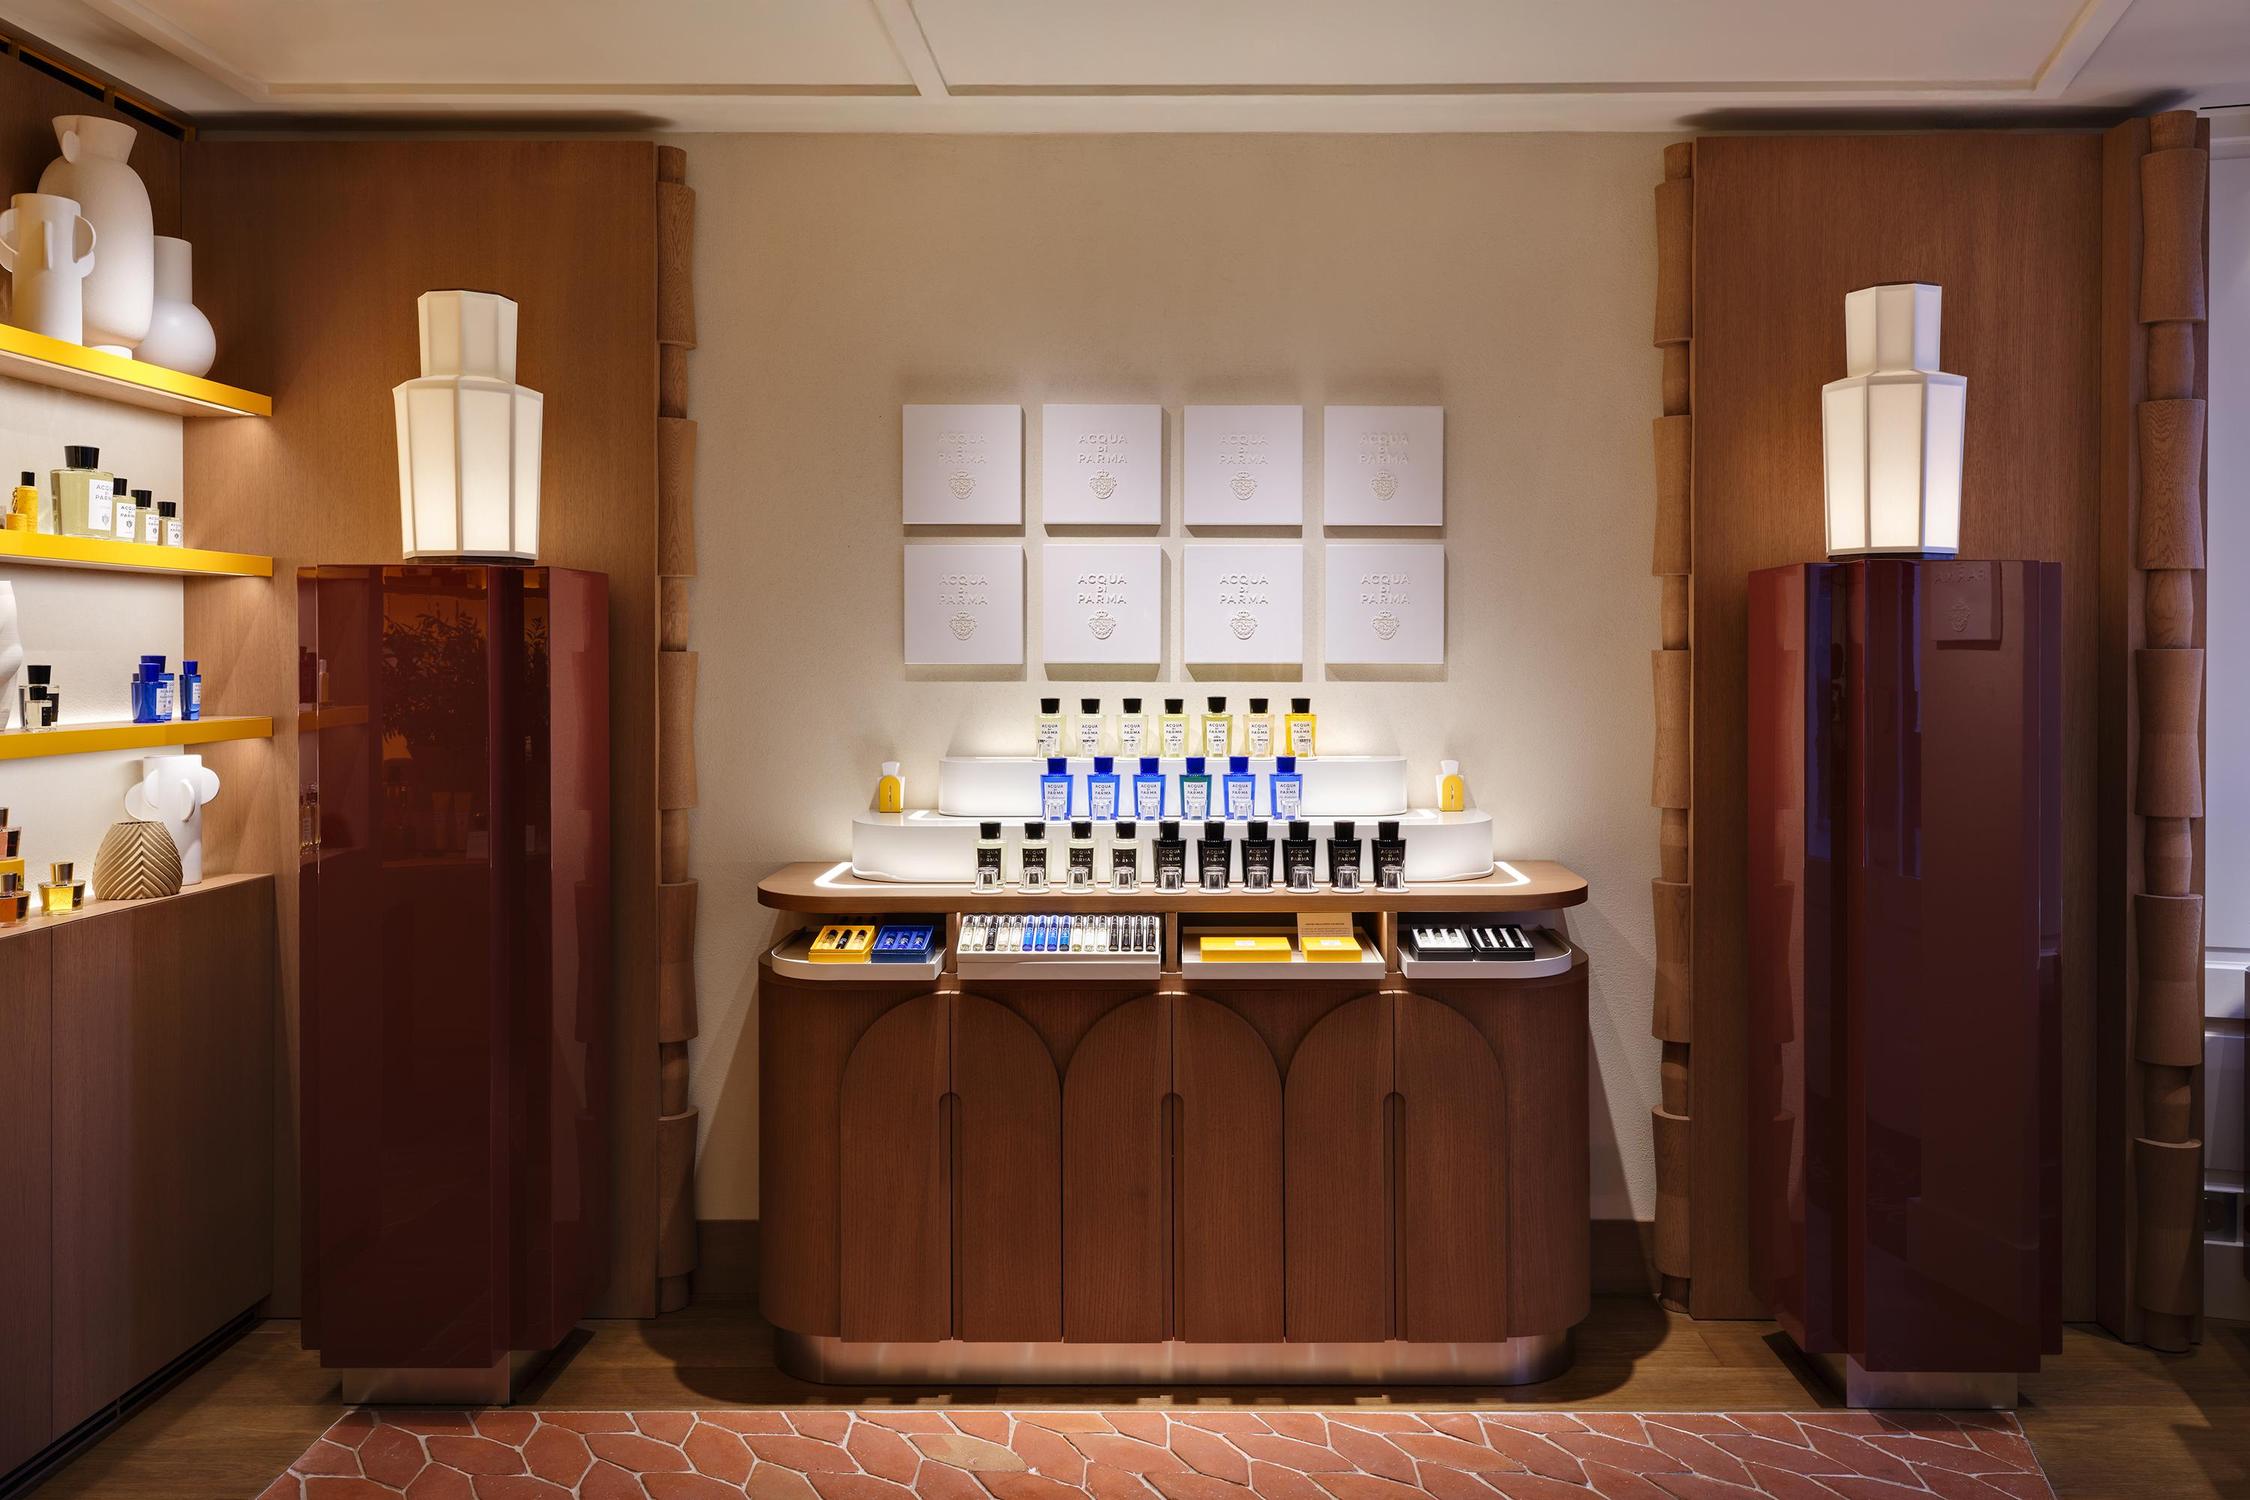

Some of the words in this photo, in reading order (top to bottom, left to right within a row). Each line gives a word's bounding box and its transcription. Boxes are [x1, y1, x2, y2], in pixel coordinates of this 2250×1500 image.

[1078, 433, 1128, 445] ACQUA
[1218, 433, 1268, 446] ACQUA
[1359, 433, 1409, 445] ACQUA
[1078, 454, 1128, 464] PARMA
[1218, 454, 1269, 465] PARMA
[1359, 454, 1409, 465] PARMA
[938, 574, 988, 586] ACQUA
[1078, 574, 1127, 586] ACQUA
[1219, 574, 1269, 586] ACQUA
[1361, 574, 1411, 586] ACQUA
[938, 595, 988, 605] PARMA
[1077, 594, 1127, 605] PARMA
[1219, 594, 1269, 605] PARMA
[1361, 595, 1411, 605] PARMA
